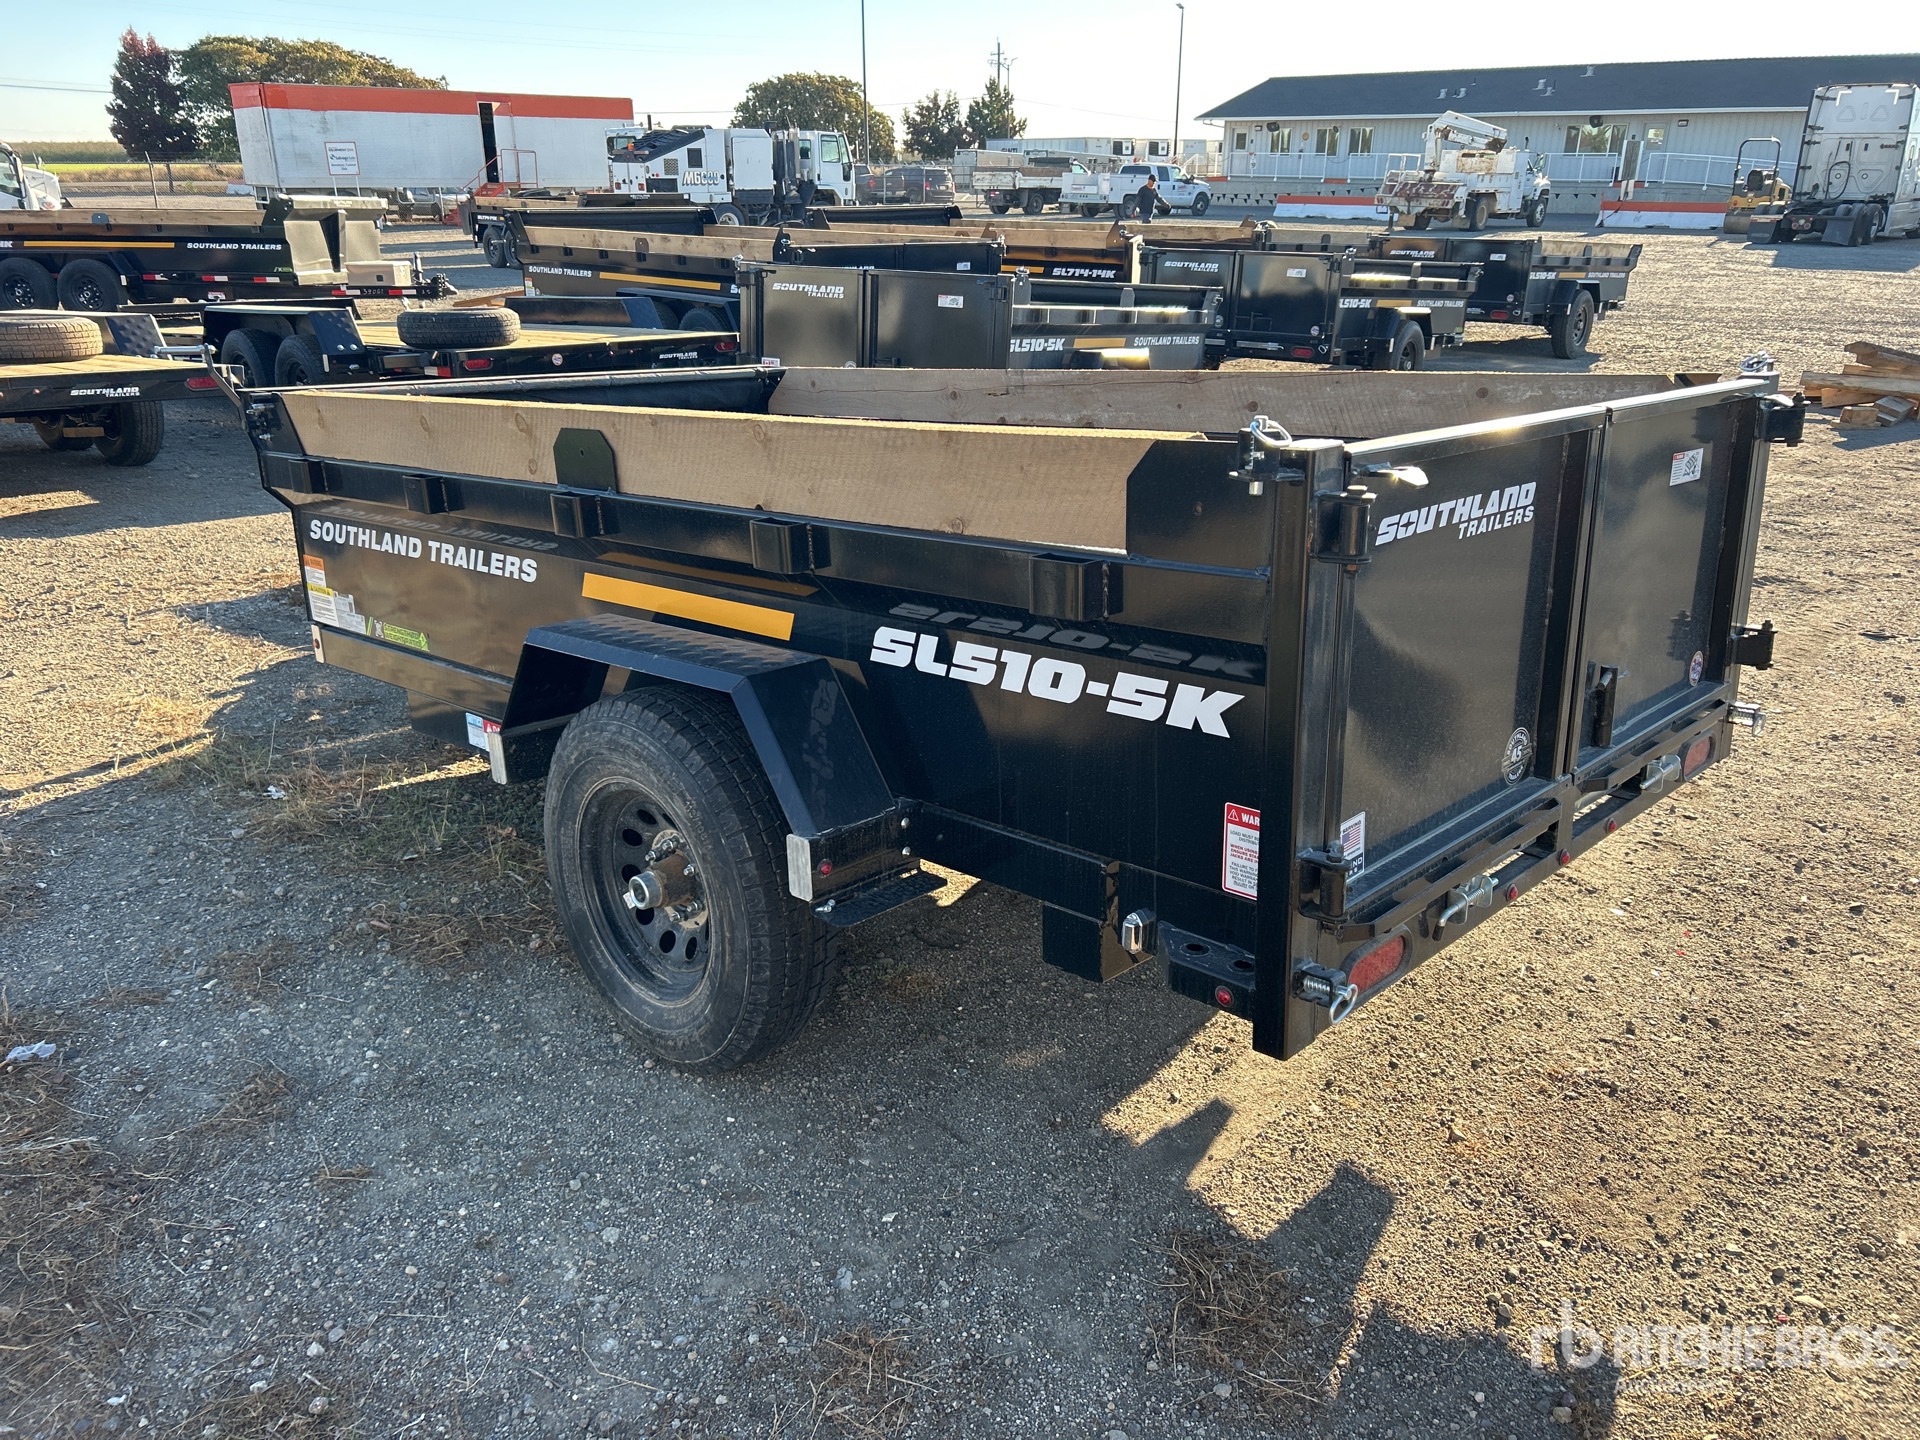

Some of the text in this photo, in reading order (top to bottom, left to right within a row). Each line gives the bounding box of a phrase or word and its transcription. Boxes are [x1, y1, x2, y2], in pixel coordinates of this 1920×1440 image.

[187, 242, 238, 250] SOUTHLAND
[1164, 260, 1219, 269] SOUTHLAND
[528, 265, 592, 277] SOUTHLAND TRAILERS
[1052, 267, 1117, 279] SL714-14K
[772, 282, 844, 294] SOUTHLAND
[1416, 299, 1443, 308] SOUTHLAND
[1444, 300, 1464, 308] TRAILERS
[1133, 336, 1171, 347] SOUTHLAND
[1172, 335, 1200, 345] TRAILERS
[70, 386, 140, 396] SOUTHLAND
[1375, 482, 1536, 546] SOUTHLAND
[1458, 505, 1535, 540] TRAILERS
[309, 519, 538, 583] SOUTHLAND TRAILERS
[869, 625, 1246, 739] SL510-5K
[1511, 745, 1523, 763] 45
[1241, 813, 1260, 826] WAR
